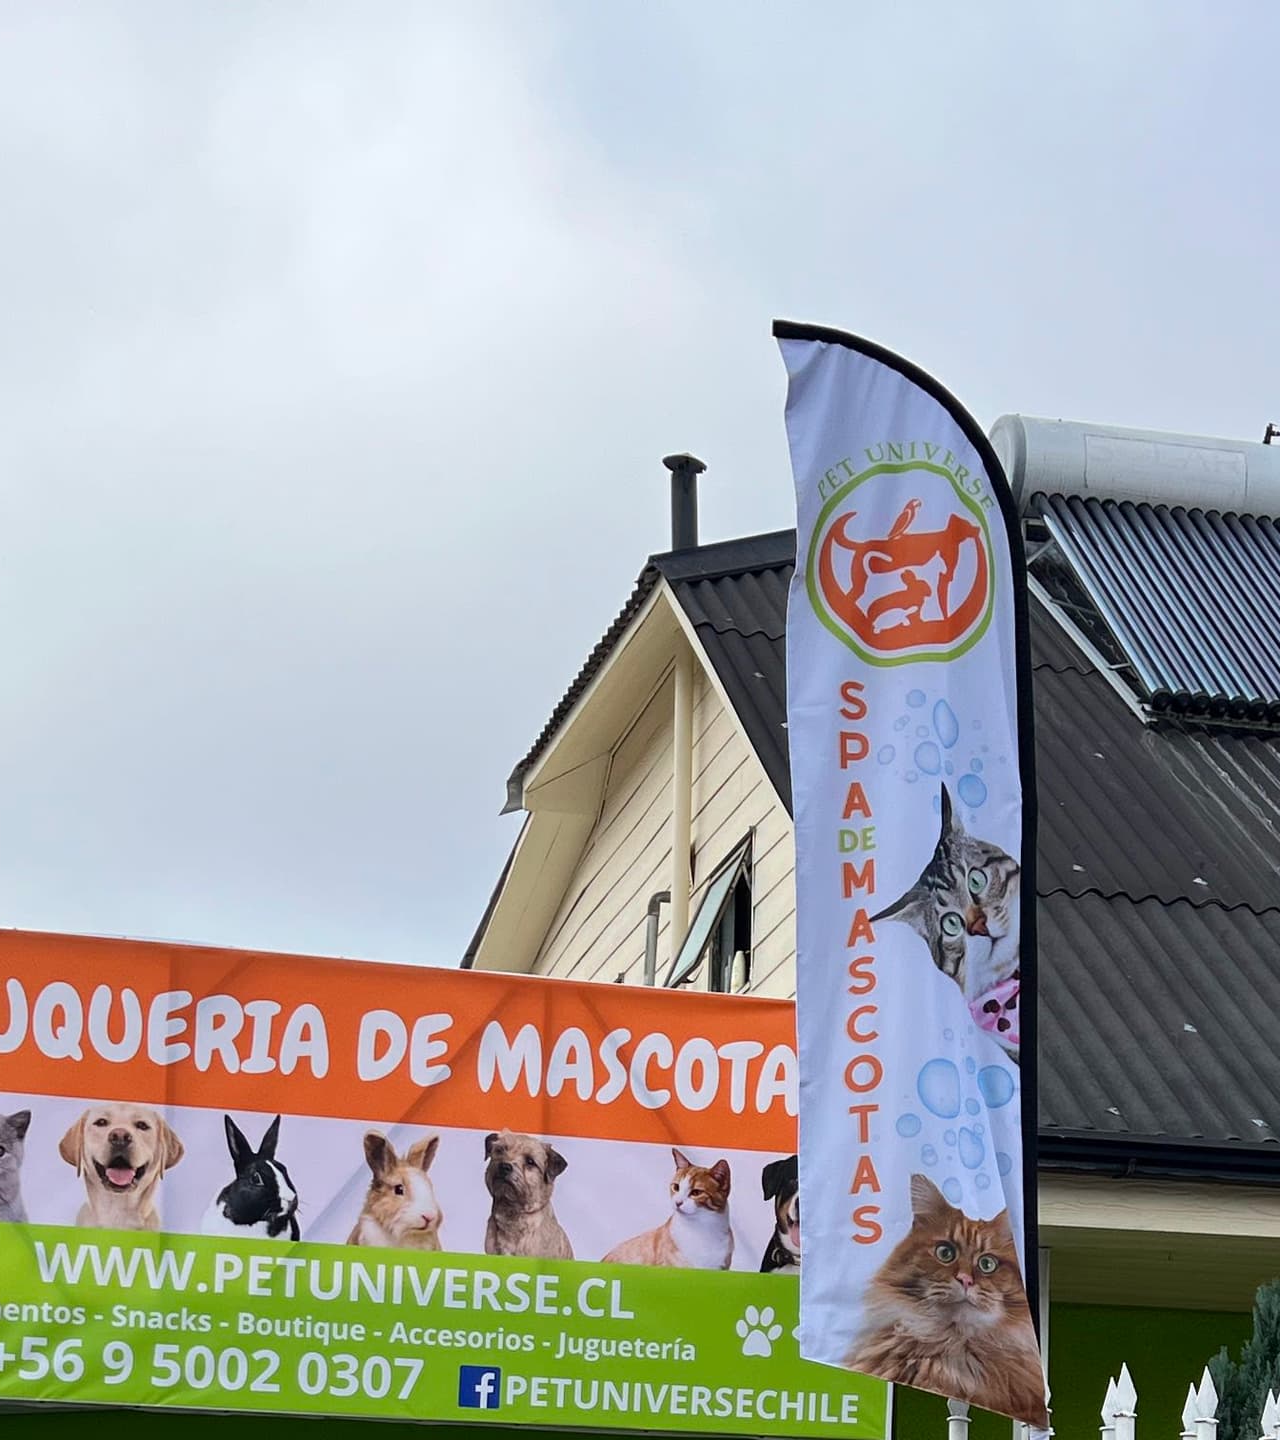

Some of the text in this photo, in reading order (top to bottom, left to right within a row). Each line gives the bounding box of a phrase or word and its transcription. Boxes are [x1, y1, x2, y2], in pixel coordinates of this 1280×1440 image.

[817, 441, 996, 510] PET UNIVERSE
[838, 679, 873, 820] SPA
[837, 826, 877, 854] DE
[356, 1009, 455, 1088] DE
[841, 858, 885, 1246] MASCOTAS
[34, 1241, 635, 1320] WWW.PETUNIVERSE.CL
[111, 1305, 212, 1333] Snacks
[237, 1312, 366, 1345] Boutique
[389, 1322, 535, 1353] Accesorios
[555, 1331, 697, 1363] Juguetería
[102, 1340, 134, 1385] 9
[150, 1343, 281, 1393] 5002
[296, 1350, 425, 1400] 0307
[506, 1374, 860, 1425] PETUNIVERSECHILE
